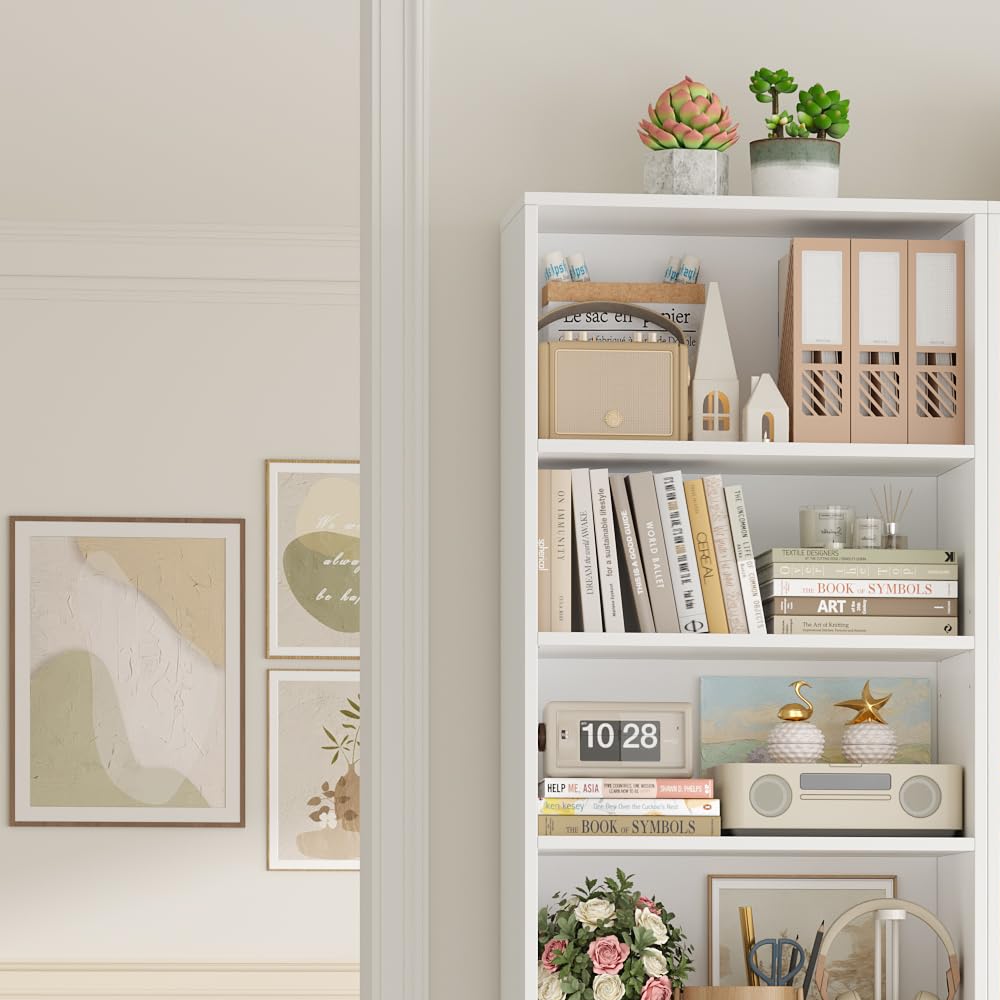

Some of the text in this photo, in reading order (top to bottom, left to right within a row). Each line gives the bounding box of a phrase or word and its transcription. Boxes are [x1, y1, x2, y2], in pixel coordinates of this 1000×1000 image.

[586, 312, 608, 323] sac
[614, 312, 632, 323] en
[643, 308, 690, 328] ppier
[558, 490, 564, 503] ON
[597, 488, 608, 516] lifestyle
[621, 511, 632, 534] GUIDE
[737, 505, 748, 538] UNCOMMON
[744, 542, 752, 558] LIFE
[600, 518, 612, 558] sustainable
[580, 511, 594, 595] DREAM AWAKE
[626, 537, 637, 560] GOOD
[646, 522, 664, 588] WORLD BALLET
[697, 532, 714, 584] CEREAL
[605, 567, 613, 577] for
[678, 564, 688, 572] WANT
[634, 577, 643, 594] THIS
[817, 583, 933, 594] BOOK SYMBOLS
[817, 600, 846, 613] ART
[582, 722, 658, 748] 10 28
[548, 784, 598, 792] HELP ASIA
[562, 802, 584, 812] kesey
[582, 820, 617, 833] BOOK
[632, 820, 696, 833] SYMBOLS
